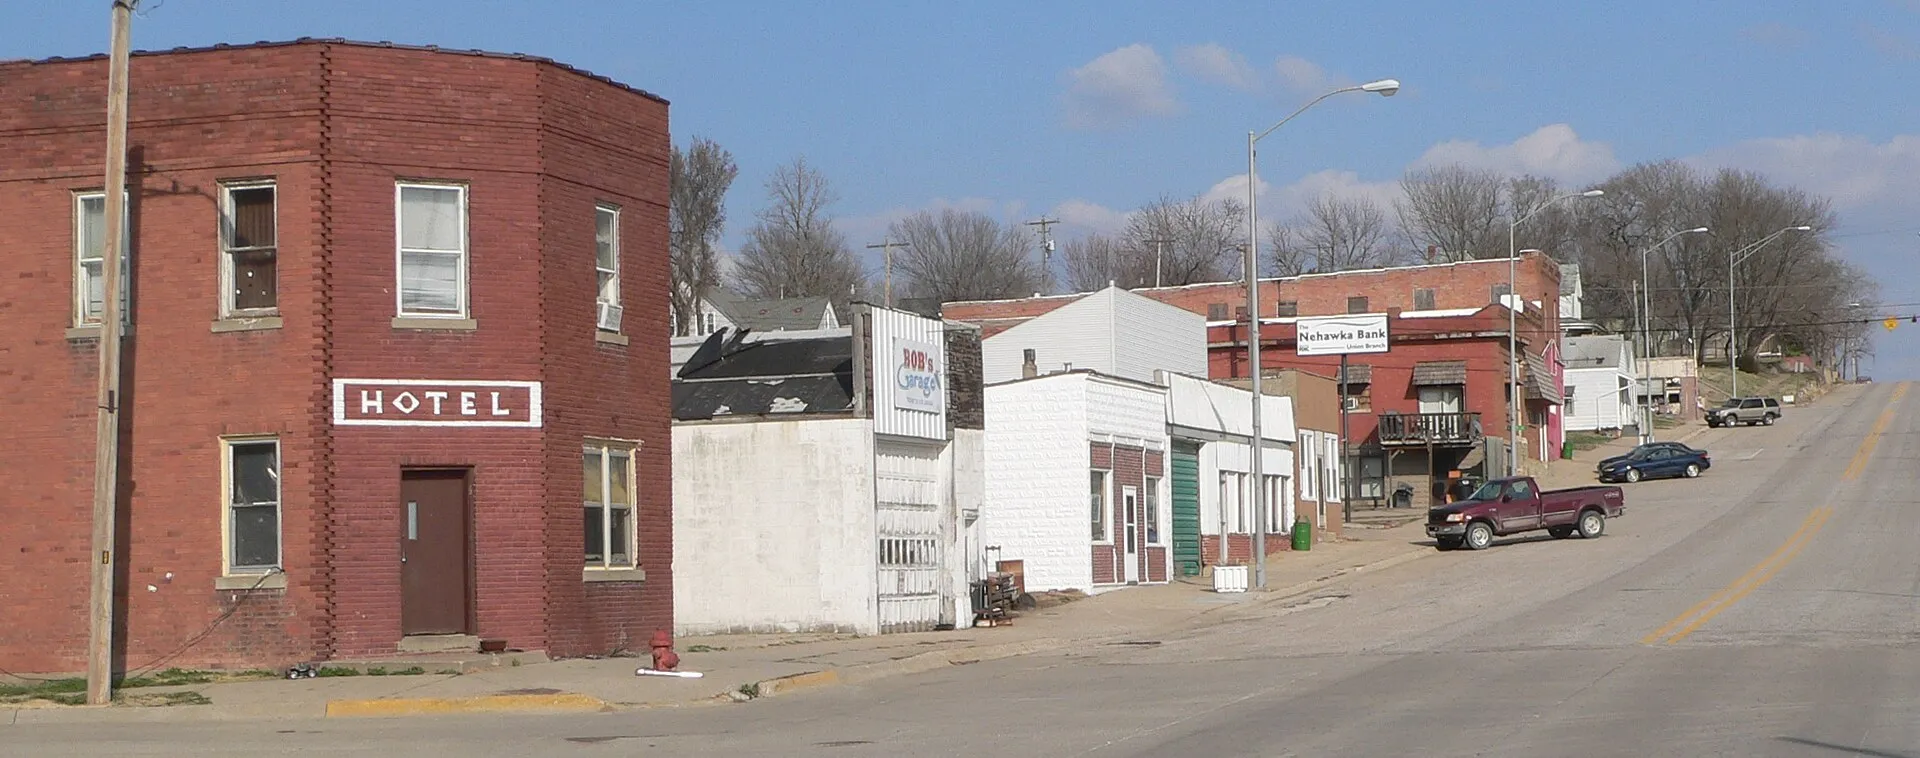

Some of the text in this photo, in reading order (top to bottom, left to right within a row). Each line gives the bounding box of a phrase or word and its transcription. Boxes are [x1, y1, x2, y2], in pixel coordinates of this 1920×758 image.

[1300, 328, 1386, 342] Nehawka Bank
[897, 364, 939, 398] Garage
[361, 390, 510, 416] HOTEL
